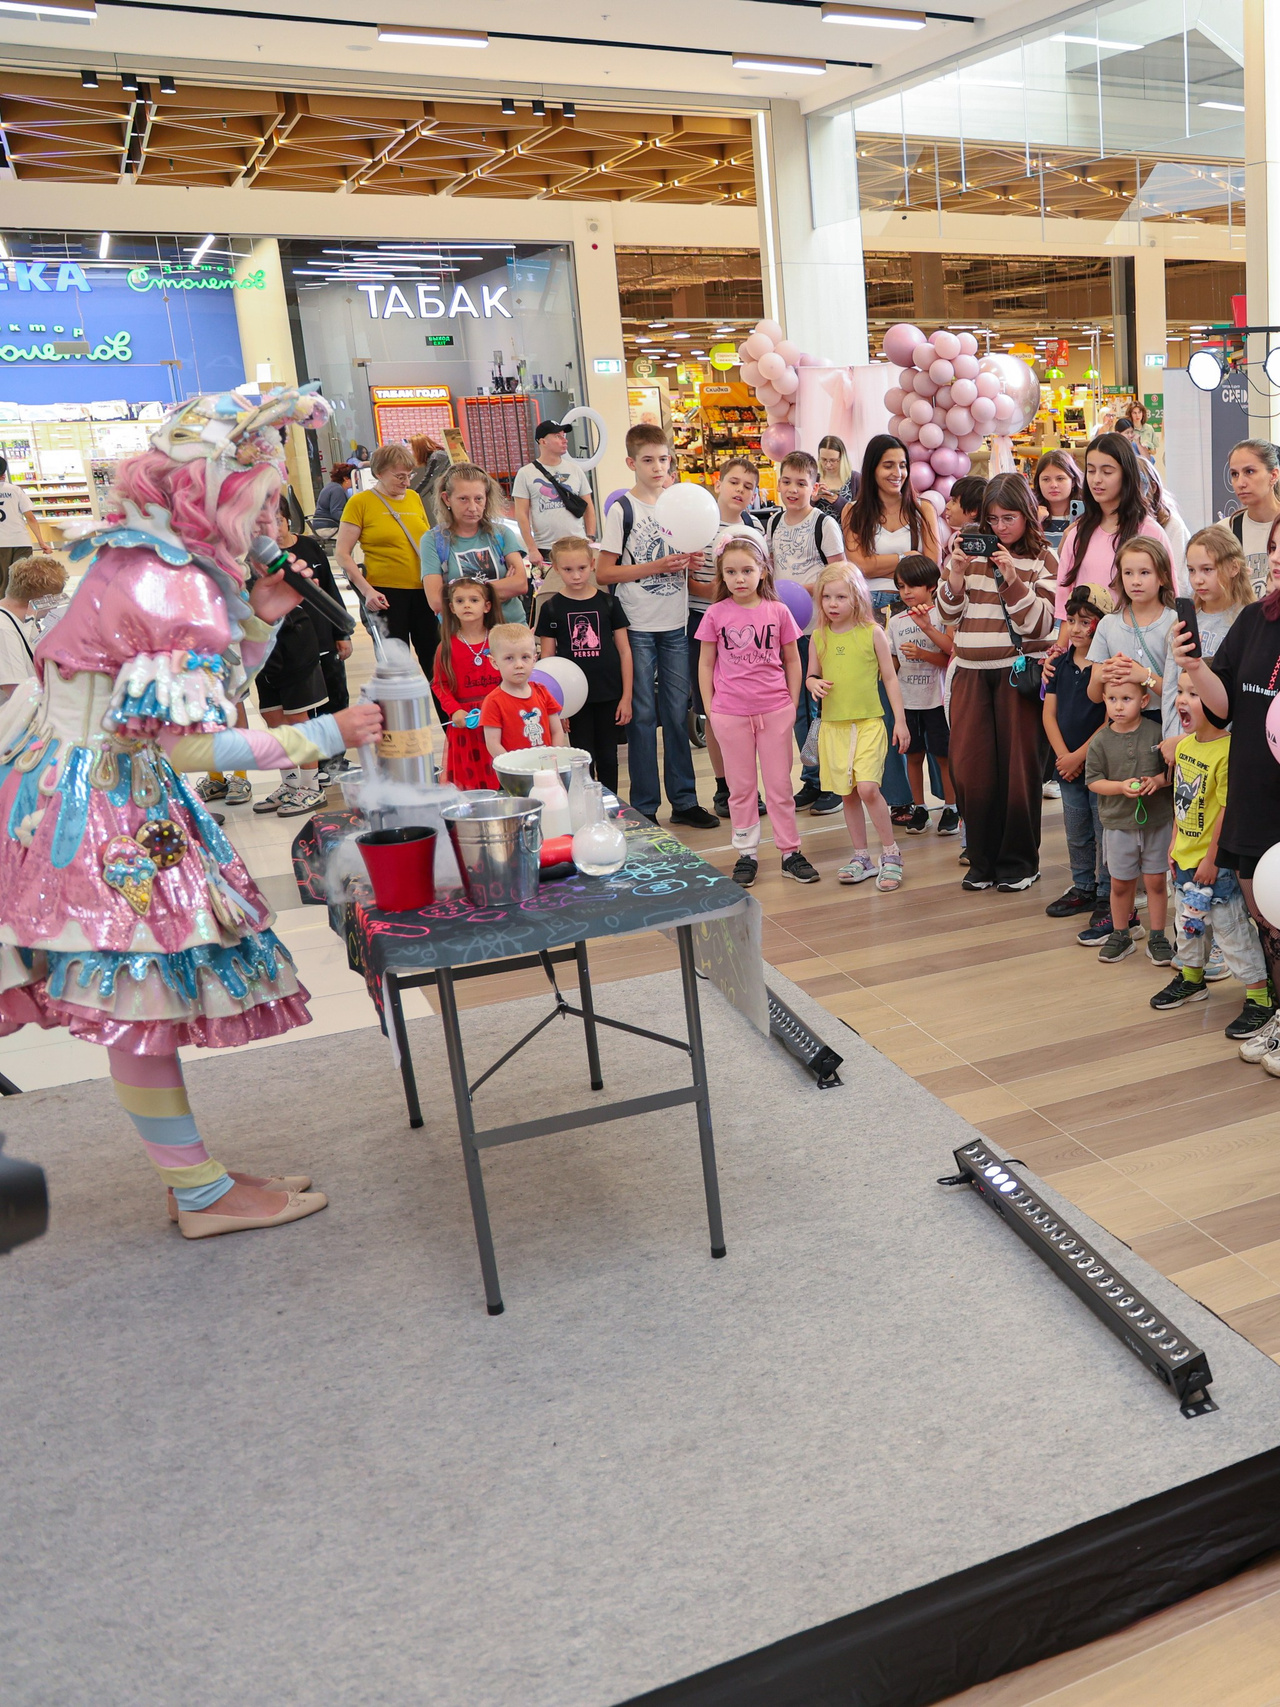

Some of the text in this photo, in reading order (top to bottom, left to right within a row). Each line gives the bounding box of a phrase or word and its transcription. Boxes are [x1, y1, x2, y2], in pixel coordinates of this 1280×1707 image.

[357, 284, 513, 319] ТАБАК
[0, 323, 84, 338] ктор
[376, 389, 447, 399] ТАБАК ГОДА
[573, 650, 600, 658] PERSON
[1200, 773, 1208, 794] GAME
